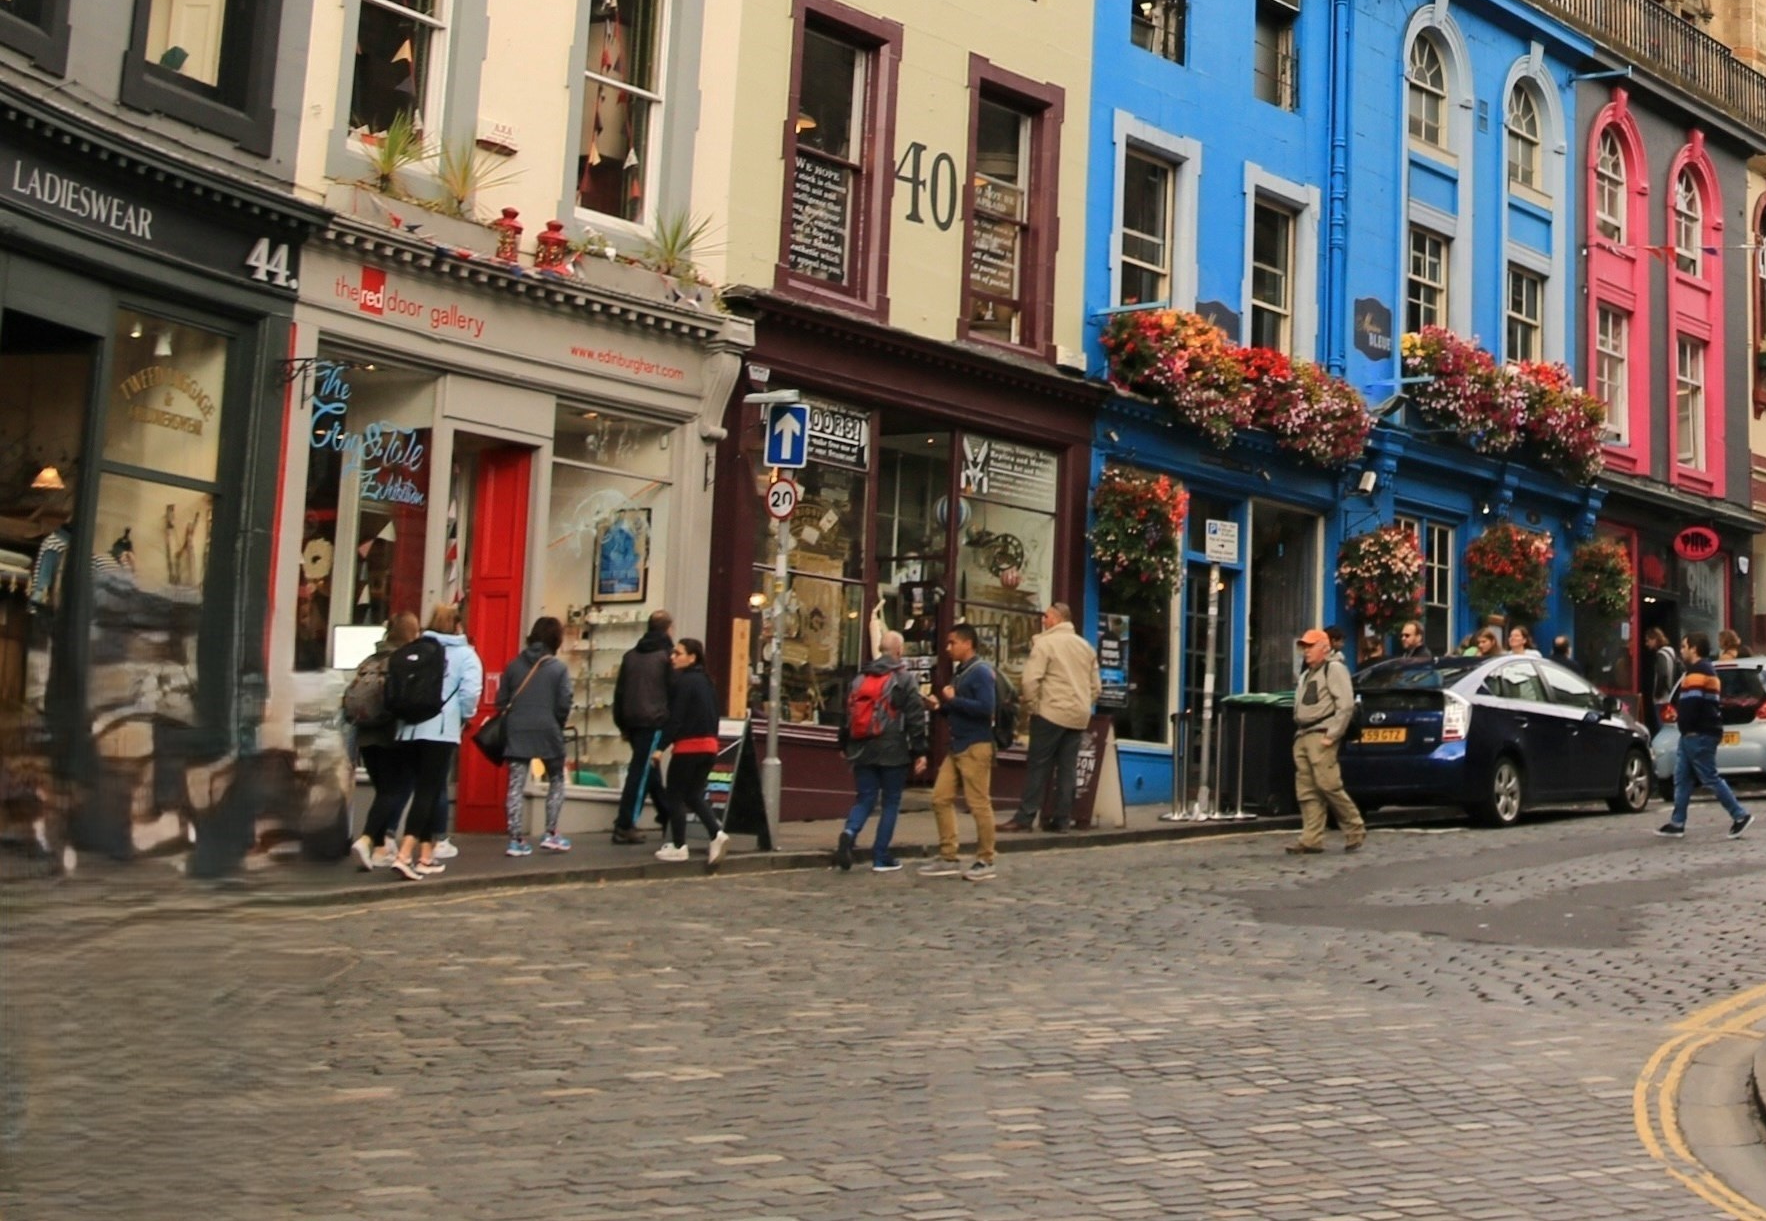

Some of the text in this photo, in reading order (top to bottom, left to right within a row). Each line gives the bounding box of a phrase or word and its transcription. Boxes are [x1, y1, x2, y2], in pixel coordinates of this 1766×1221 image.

[814, 162, 841, 181] HOPE
[894, 141, 957, 232] 40
[12, 160, 153, 240] LADIESWEAR
[335, 274, 485, 339] the red door gallery
[1368, 332, 1392, 352] BLEUE
[315, 360, 352, 400] The
[570, 344, 685, 381] www.edinburghart.com
[809, 408, 862, 441] OORS!
[771, 491, 793, 508] 20
